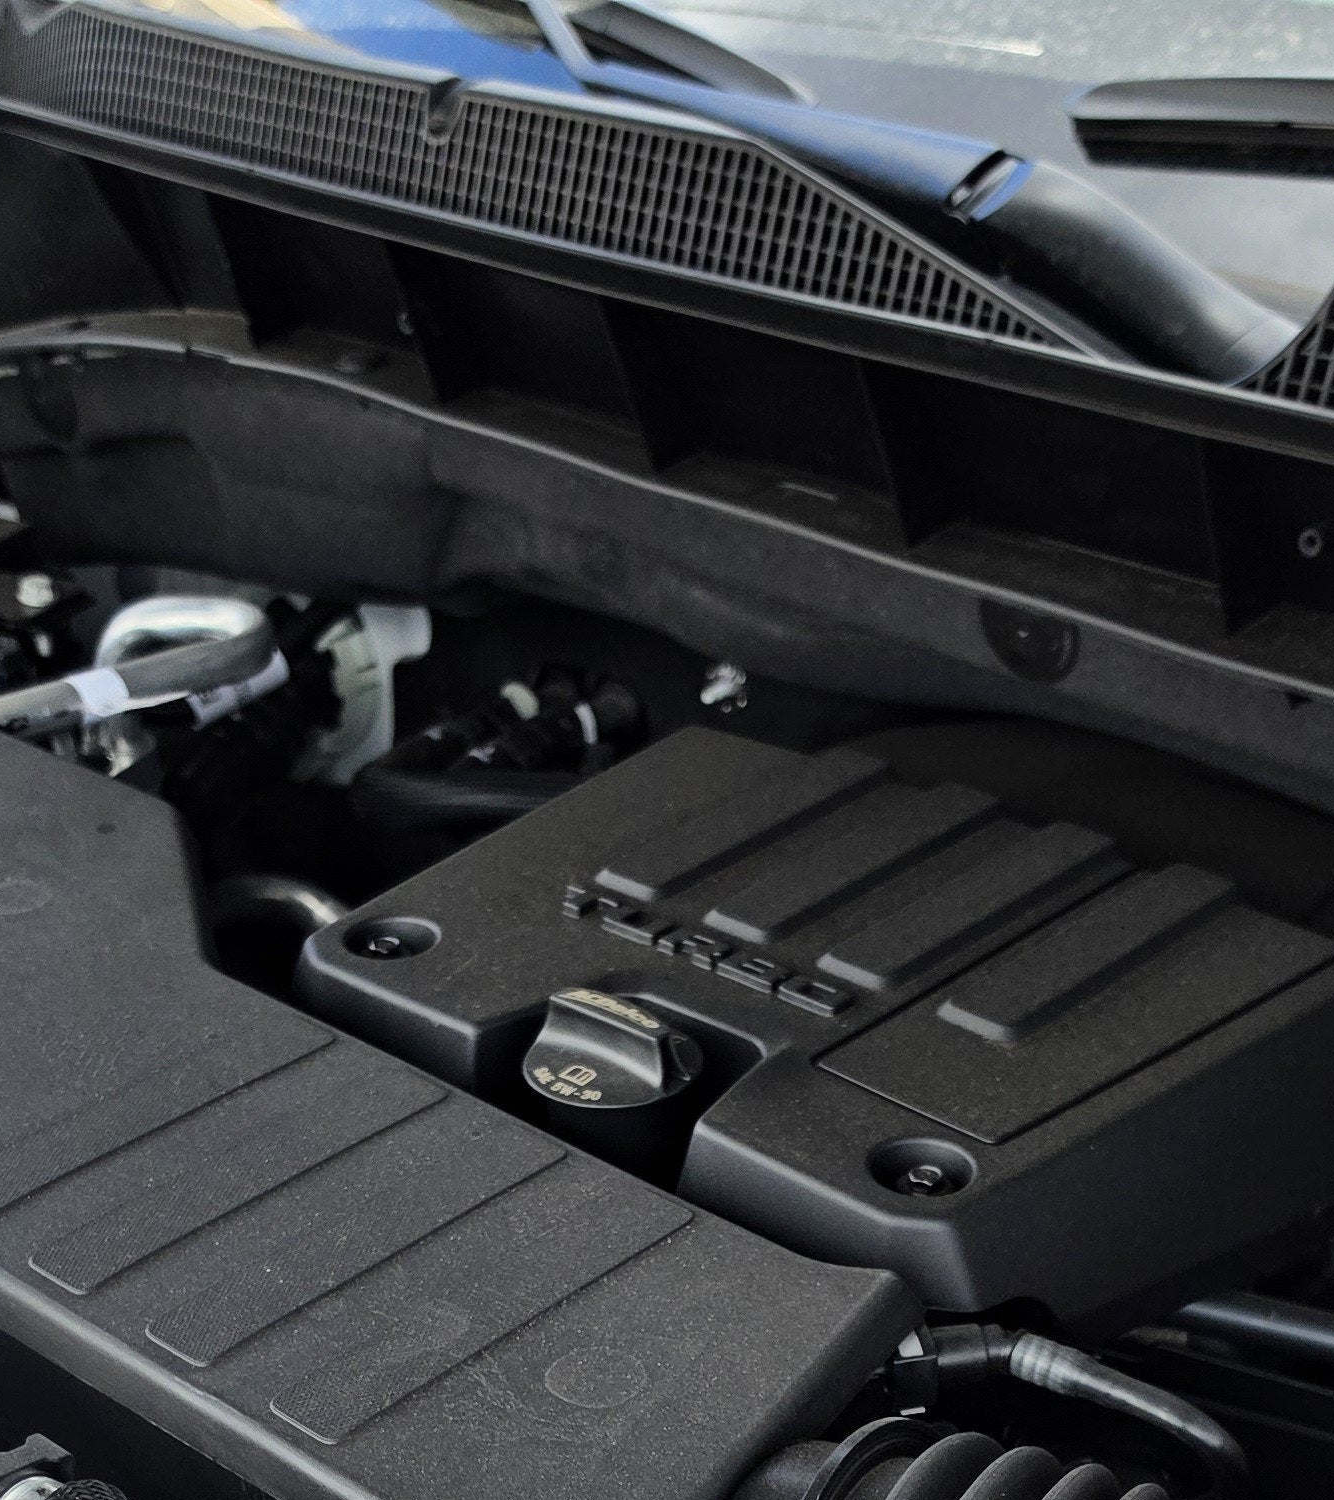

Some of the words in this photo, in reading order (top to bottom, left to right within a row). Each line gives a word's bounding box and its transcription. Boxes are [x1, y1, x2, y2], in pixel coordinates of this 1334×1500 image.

[562, 885, 851, 1018] TURBO
[558, 989, 661, 1029] ACDelco
[532, 1067, 556, 1085] SAE
